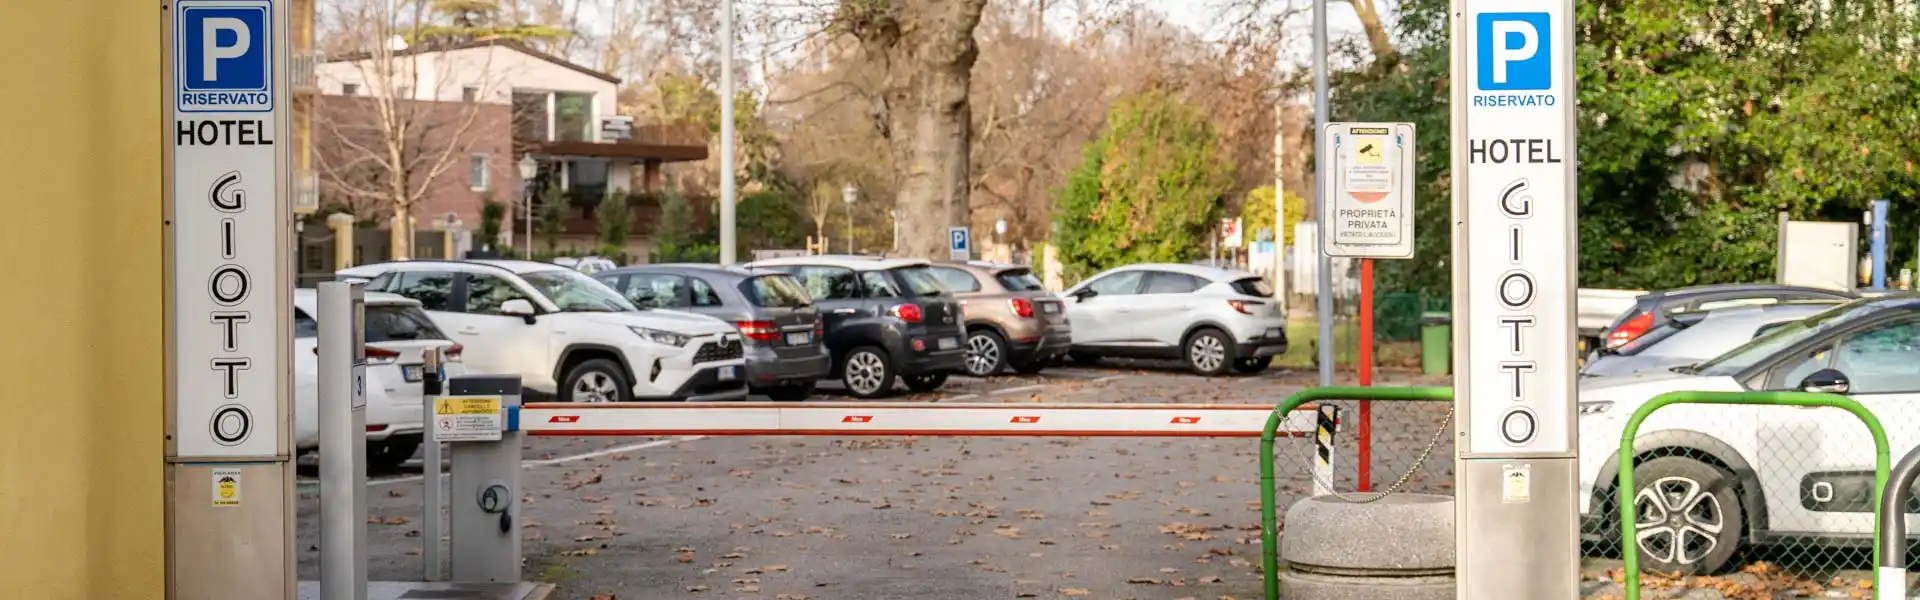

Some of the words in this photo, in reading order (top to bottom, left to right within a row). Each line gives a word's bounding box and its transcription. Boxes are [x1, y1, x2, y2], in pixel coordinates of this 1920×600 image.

[202, 17, 251, 81] P
[1492, 20, 1538, 83] P
[182, 93, 268, 105] RISERVATO
[1473, 95, 1555, 106] RISERVATO
[177, 120, 273, 146] HOTEL
[1470, 139, 1561, 163] HOTEL
[1340, 208, 1396, 218] PROPRIETÀ
[1348, 220, 1388, 229] PRIVATA
[954, 231, 964, 248] P
[208, 170, 253, 446] GIOTTO
[1496, 177, 1539, 447] GIOTTO
[357, 376, 362, 396] 3
